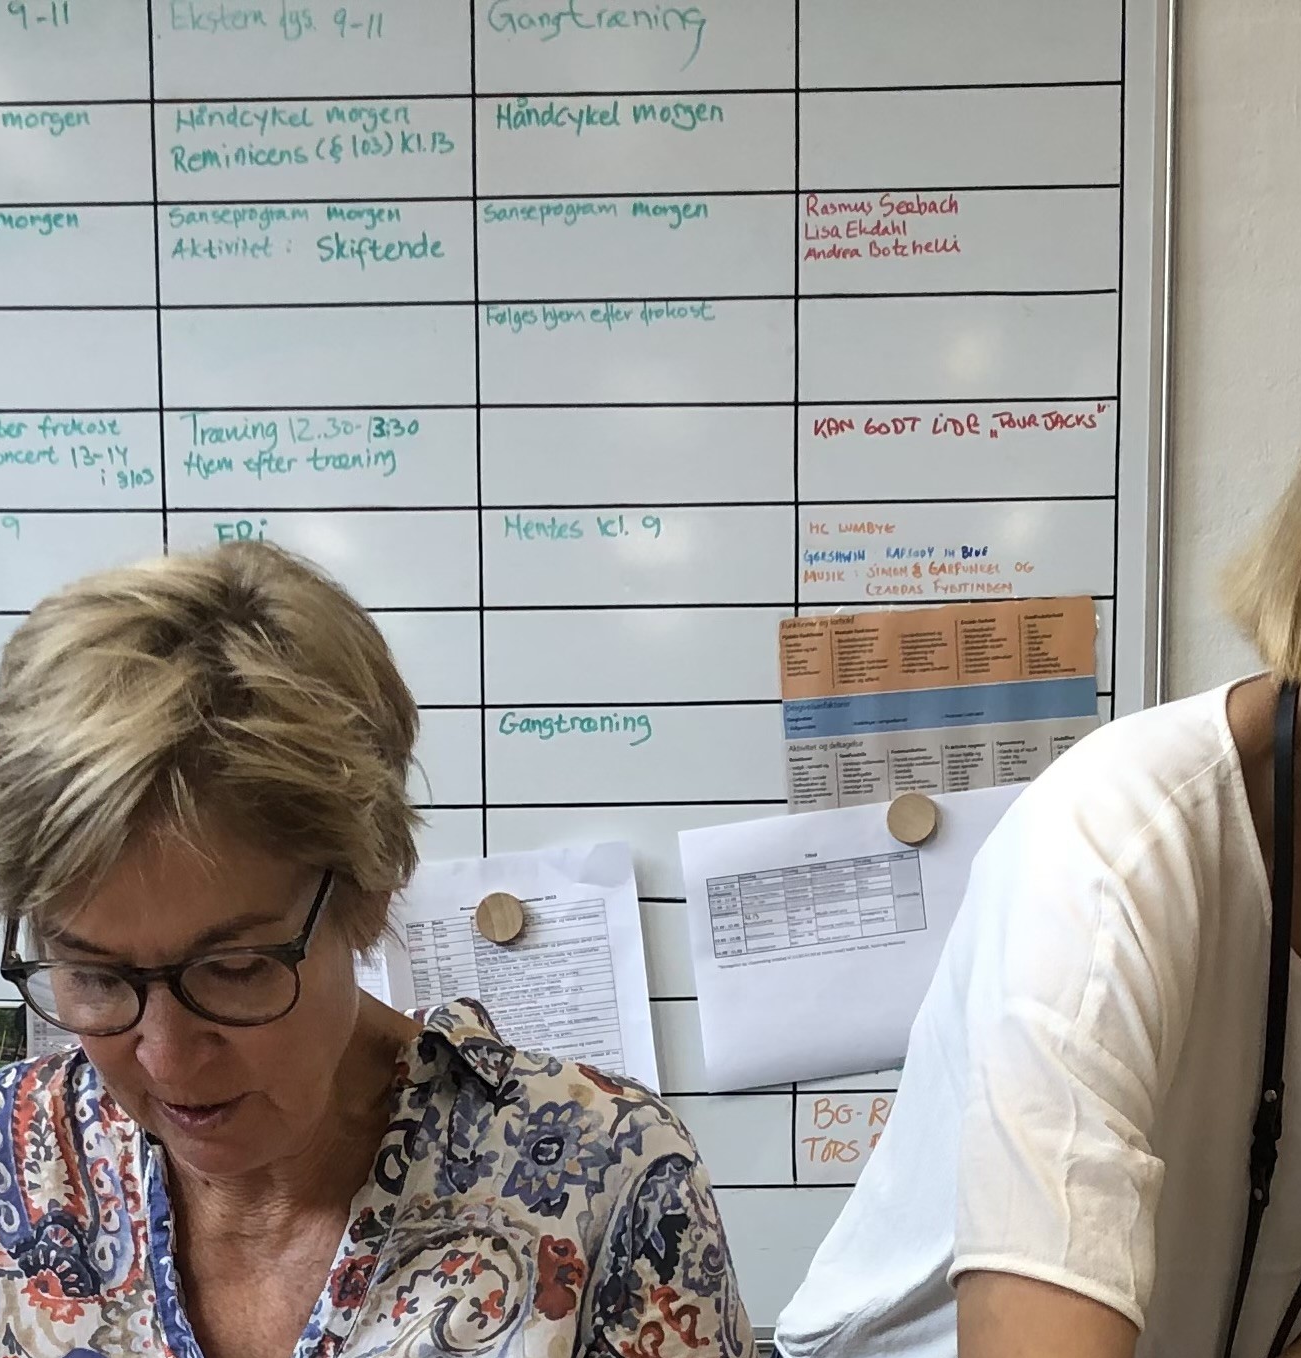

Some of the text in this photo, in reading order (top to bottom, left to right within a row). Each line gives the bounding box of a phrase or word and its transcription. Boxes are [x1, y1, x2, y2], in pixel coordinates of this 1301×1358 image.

[8, 1, 70, 30] 9-11
[333, 7, 383, 39] 9-11
[1, 109, 91, 137] morgen
[176, 105, 314, 136] Håndcykel
[497, 96, 725, 137] Håndcykel morgen
[169, 206, 309, 230] Sanseprogram
[483, 202, 617, 227] Sanseprogram
[805, 192, 873, 217] Rasmus
[804, 222, 842, 240] Lisa
[317, 231, 445, 270] Skiftende
[804, 243, 862, 261] Andrea
[813, 416, 922, 438] KAN GODT
[243, 451, 298, 481] efter
[306, 447, 396, 477] træning
[2, 516, 21, 540] 9
[504, 514, 584, 540] Hentes
[641, 515, 661, 538] 9
[499, 711, 652, 747] Gangtræning
[801, 1135, 860, 1163] TORS
